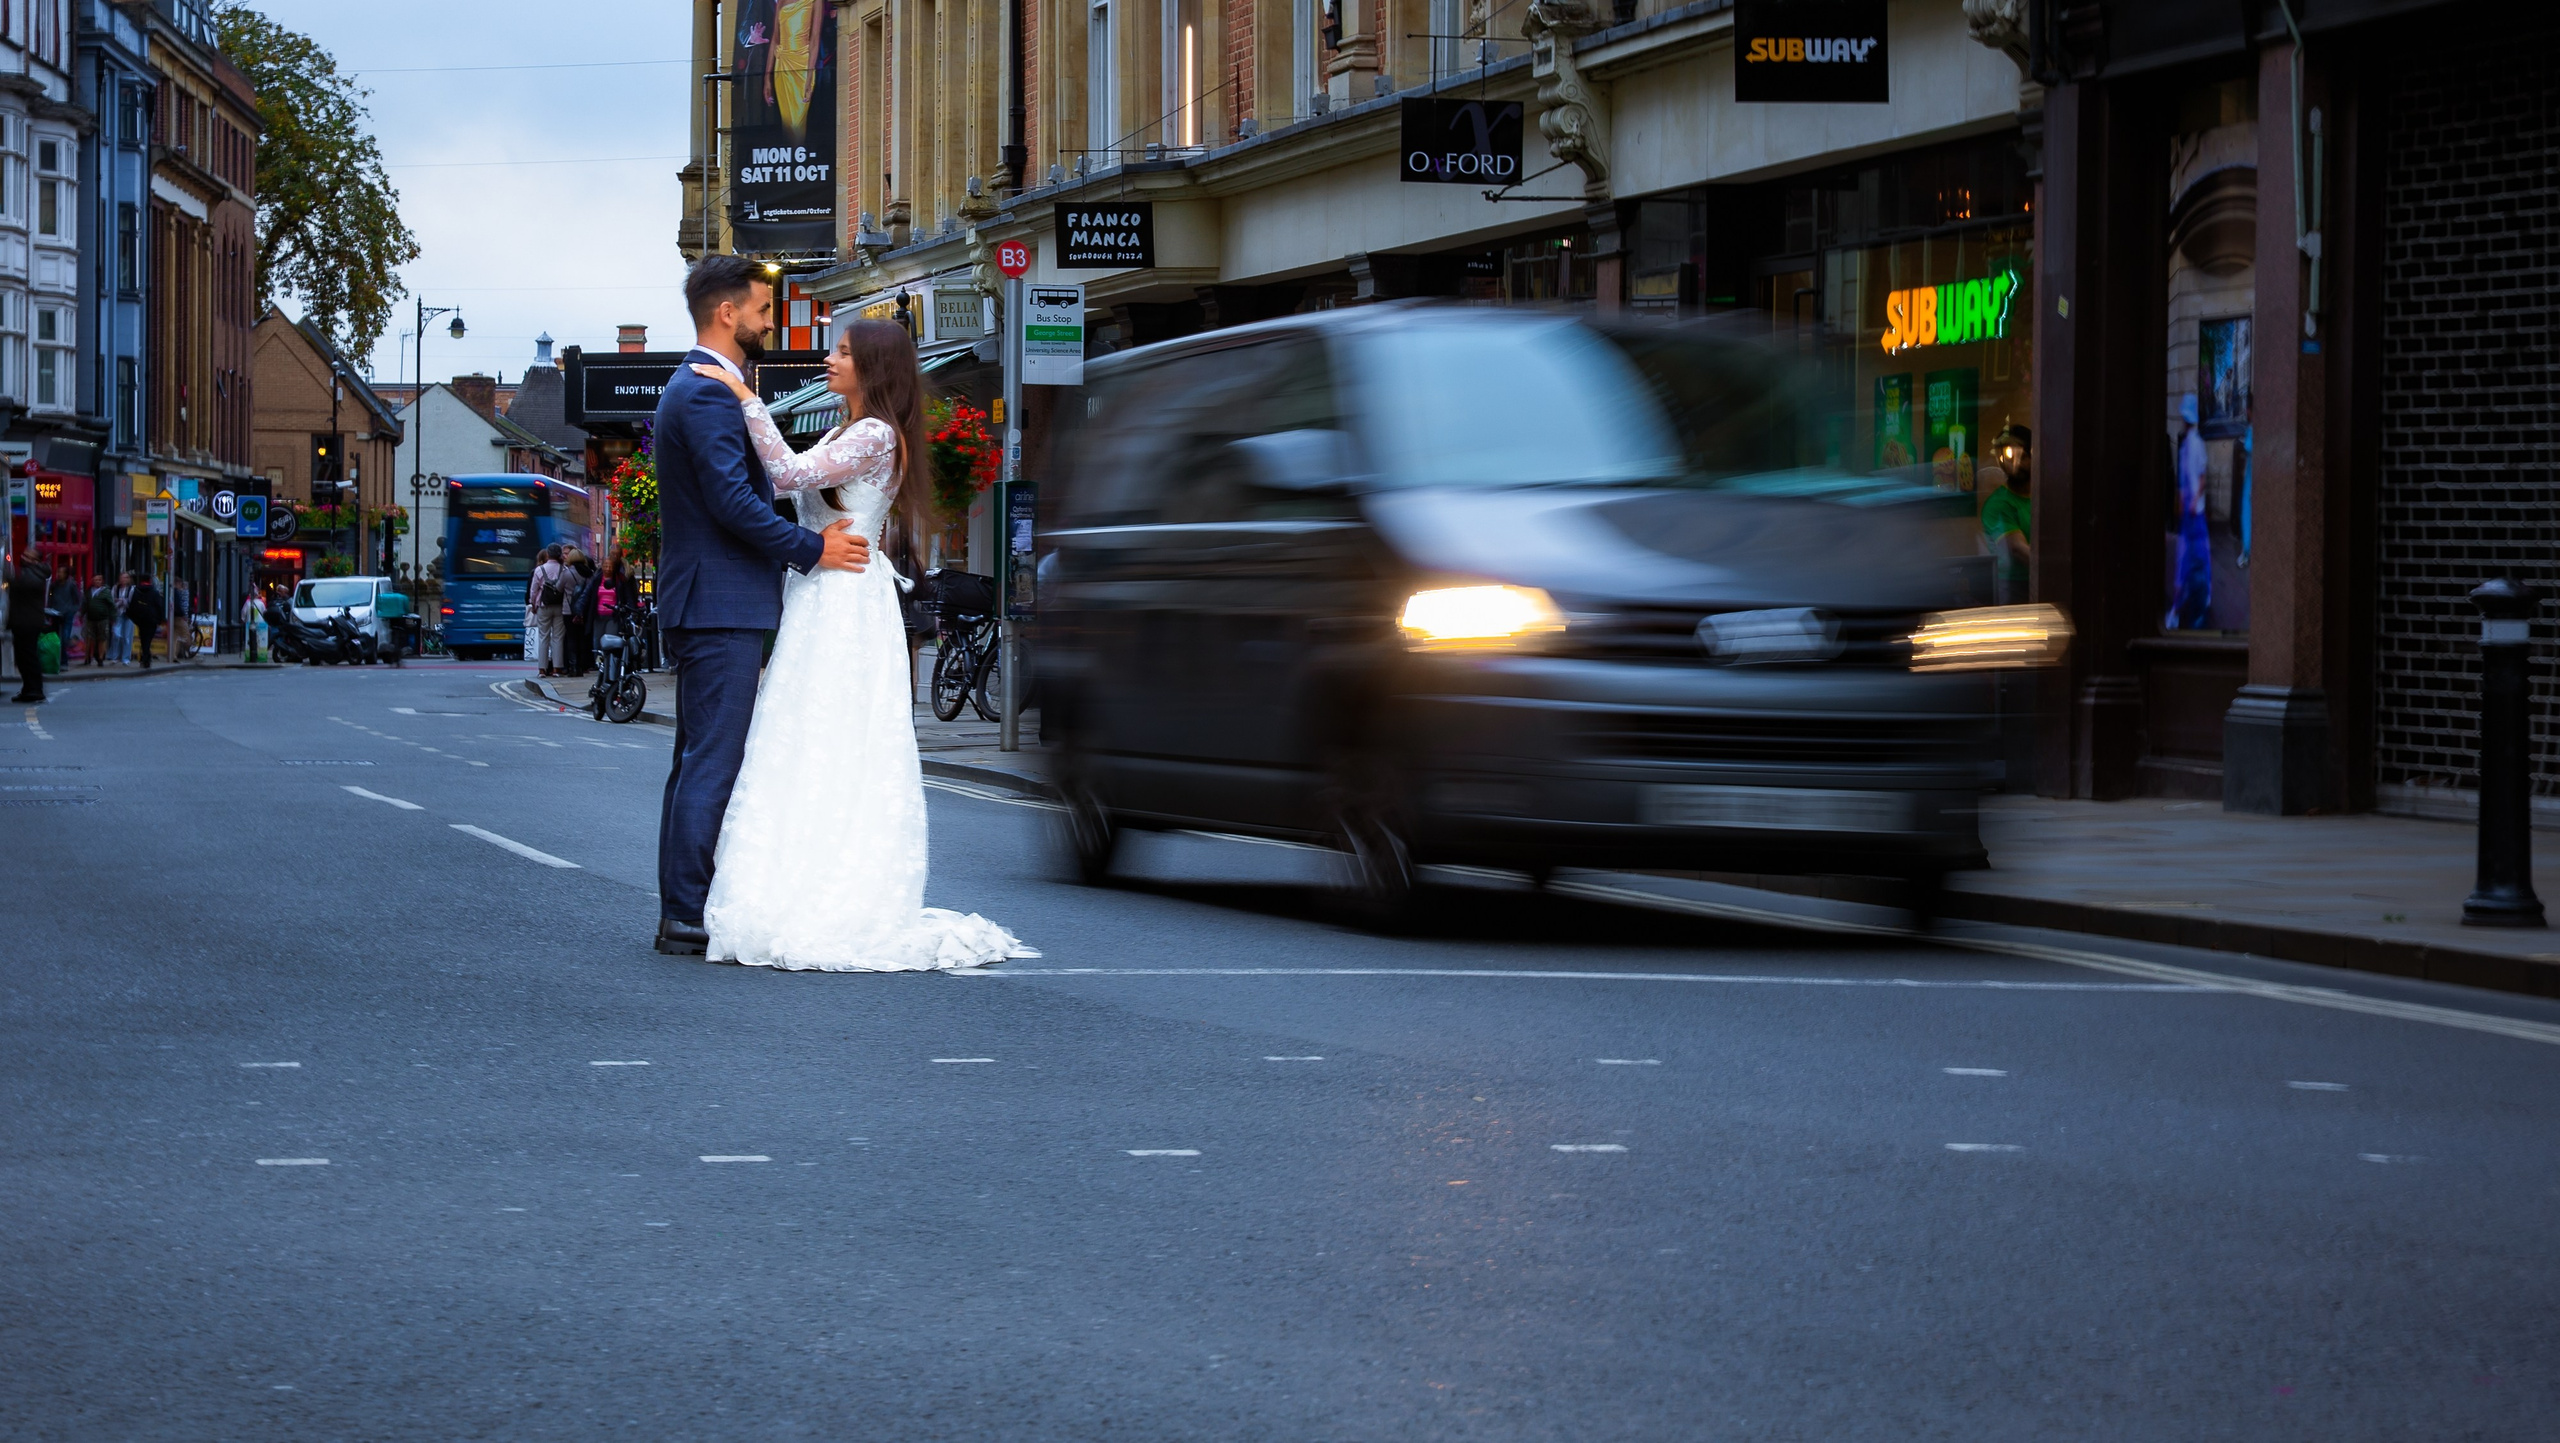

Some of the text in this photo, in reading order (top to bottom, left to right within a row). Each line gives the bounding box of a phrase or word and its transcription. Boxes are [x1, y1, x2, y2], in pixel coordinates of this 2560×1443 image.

[1745, 36, 1878, 64] SUBWAY
[752, 147, 792, 165] MON
[794, 146, 807, 163] 6
[741, 165, 830, 184] SAT 11 OCT
[1067, 212, 1142, 228] FRANCO
[1070, 230, 1141, 247] MANCA
[1002, 248, 1027, 268] B3
[1068, 252, 1143, 261] SOURDOUGH PIZZA
[939, 302, 978, 314] BELLA
[1881, 269, 2012, 355] SUBWAY
[939, 316, 980, 328] ITALIA
[1036, 313, 1072, 325] Bus Stop
[1033, 329, 1056, 338] George
[1025, 347, 1050, 355] University
[614, 385, 640, 395] ENJOY
[640, 386, 657, 395] THE
[1014, 490, 1035, 501] airline
[244, 506, 259, 514] ZEZ
[524, 627, 536, 660] M&S
